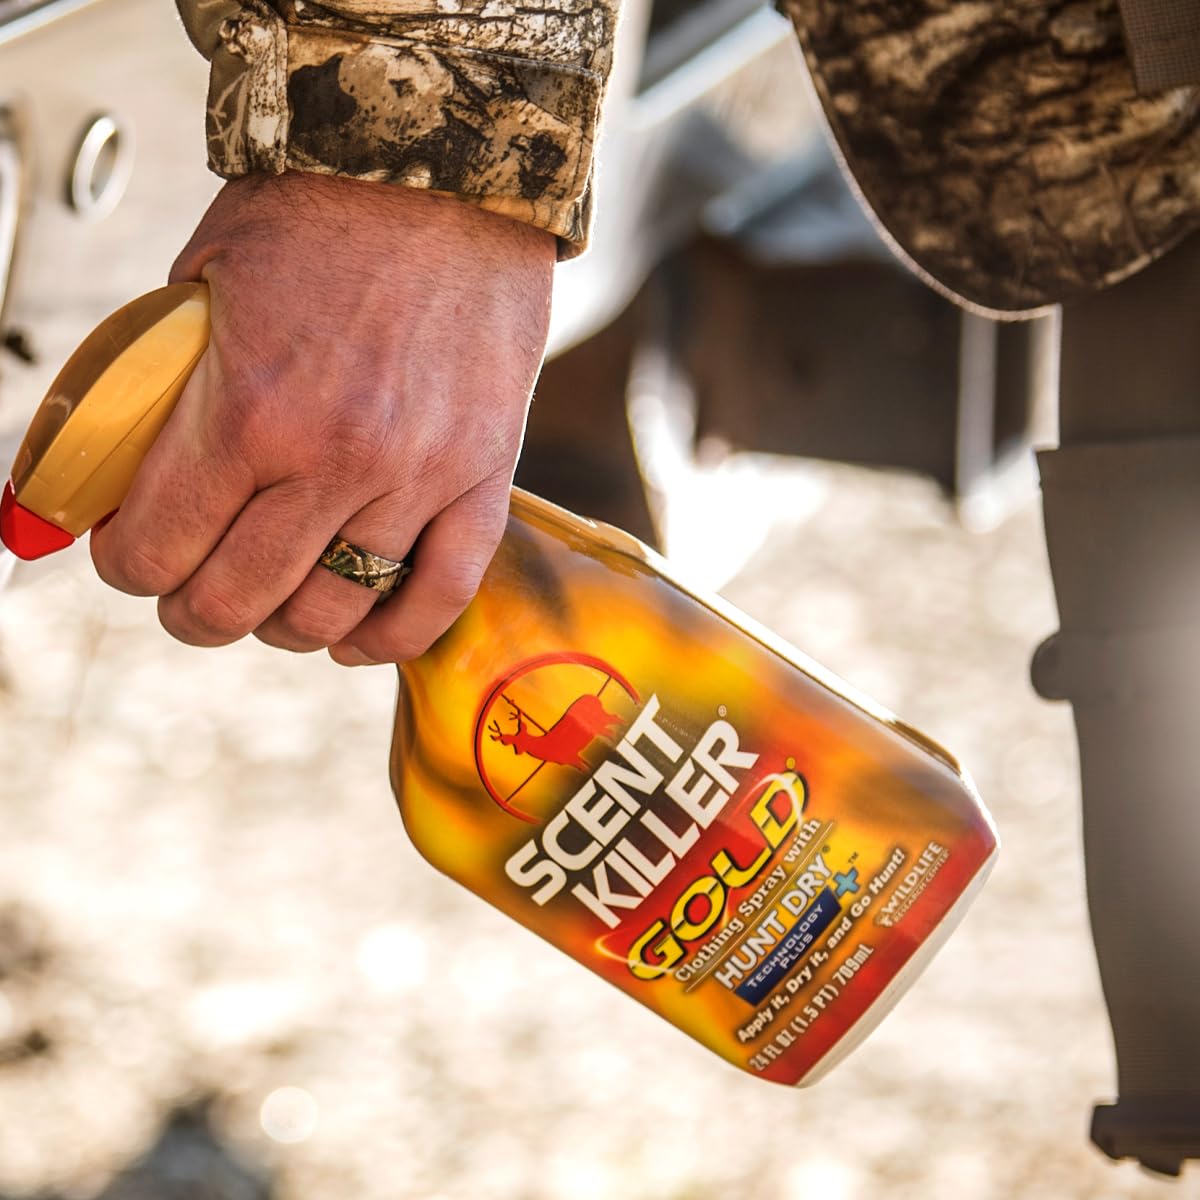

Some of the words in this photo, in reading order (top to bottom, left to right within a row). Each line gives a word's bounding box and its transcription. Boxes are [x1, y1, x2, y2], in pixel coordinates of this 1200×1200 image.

[504, 693, 684, 906] SCENT
[571, 720, 760, 929] KILLER
[628, 770, 809, 979] GOLD
[675, 917, 745, 982] Clothing
[738, 865, 787, 917] Spray
[784, 819, 821, 863] with
[714, 909, 786, 989] HUNT
[781, 854, 833, 917] DRY
[737, 1007, 774, 1042] Apply
[770, 994, 790, 1010] it,
[785, 966, 813, 994] Dry
[809, 950, 830, 967] it,
[827, 916, 852, 949] and
[850, 895, 872, 917] Go
[868, 848, 905, 895] Hunt!
[746, 903, 824, 988] TECHNOLOGY
[881, 841, 942, 913] WILDLIFE
[750, 1054, 770, 1071] 24
[764, 1044, 783, 1060] FL
[775, 1029, 797, 1048] OZ
[790, 1005, 819, 1034] (1.5
[812, 984, 840, 1009] PT)
[832, 943, 874, 986] 709mL
[780, 934, 814, 970] PLUS
